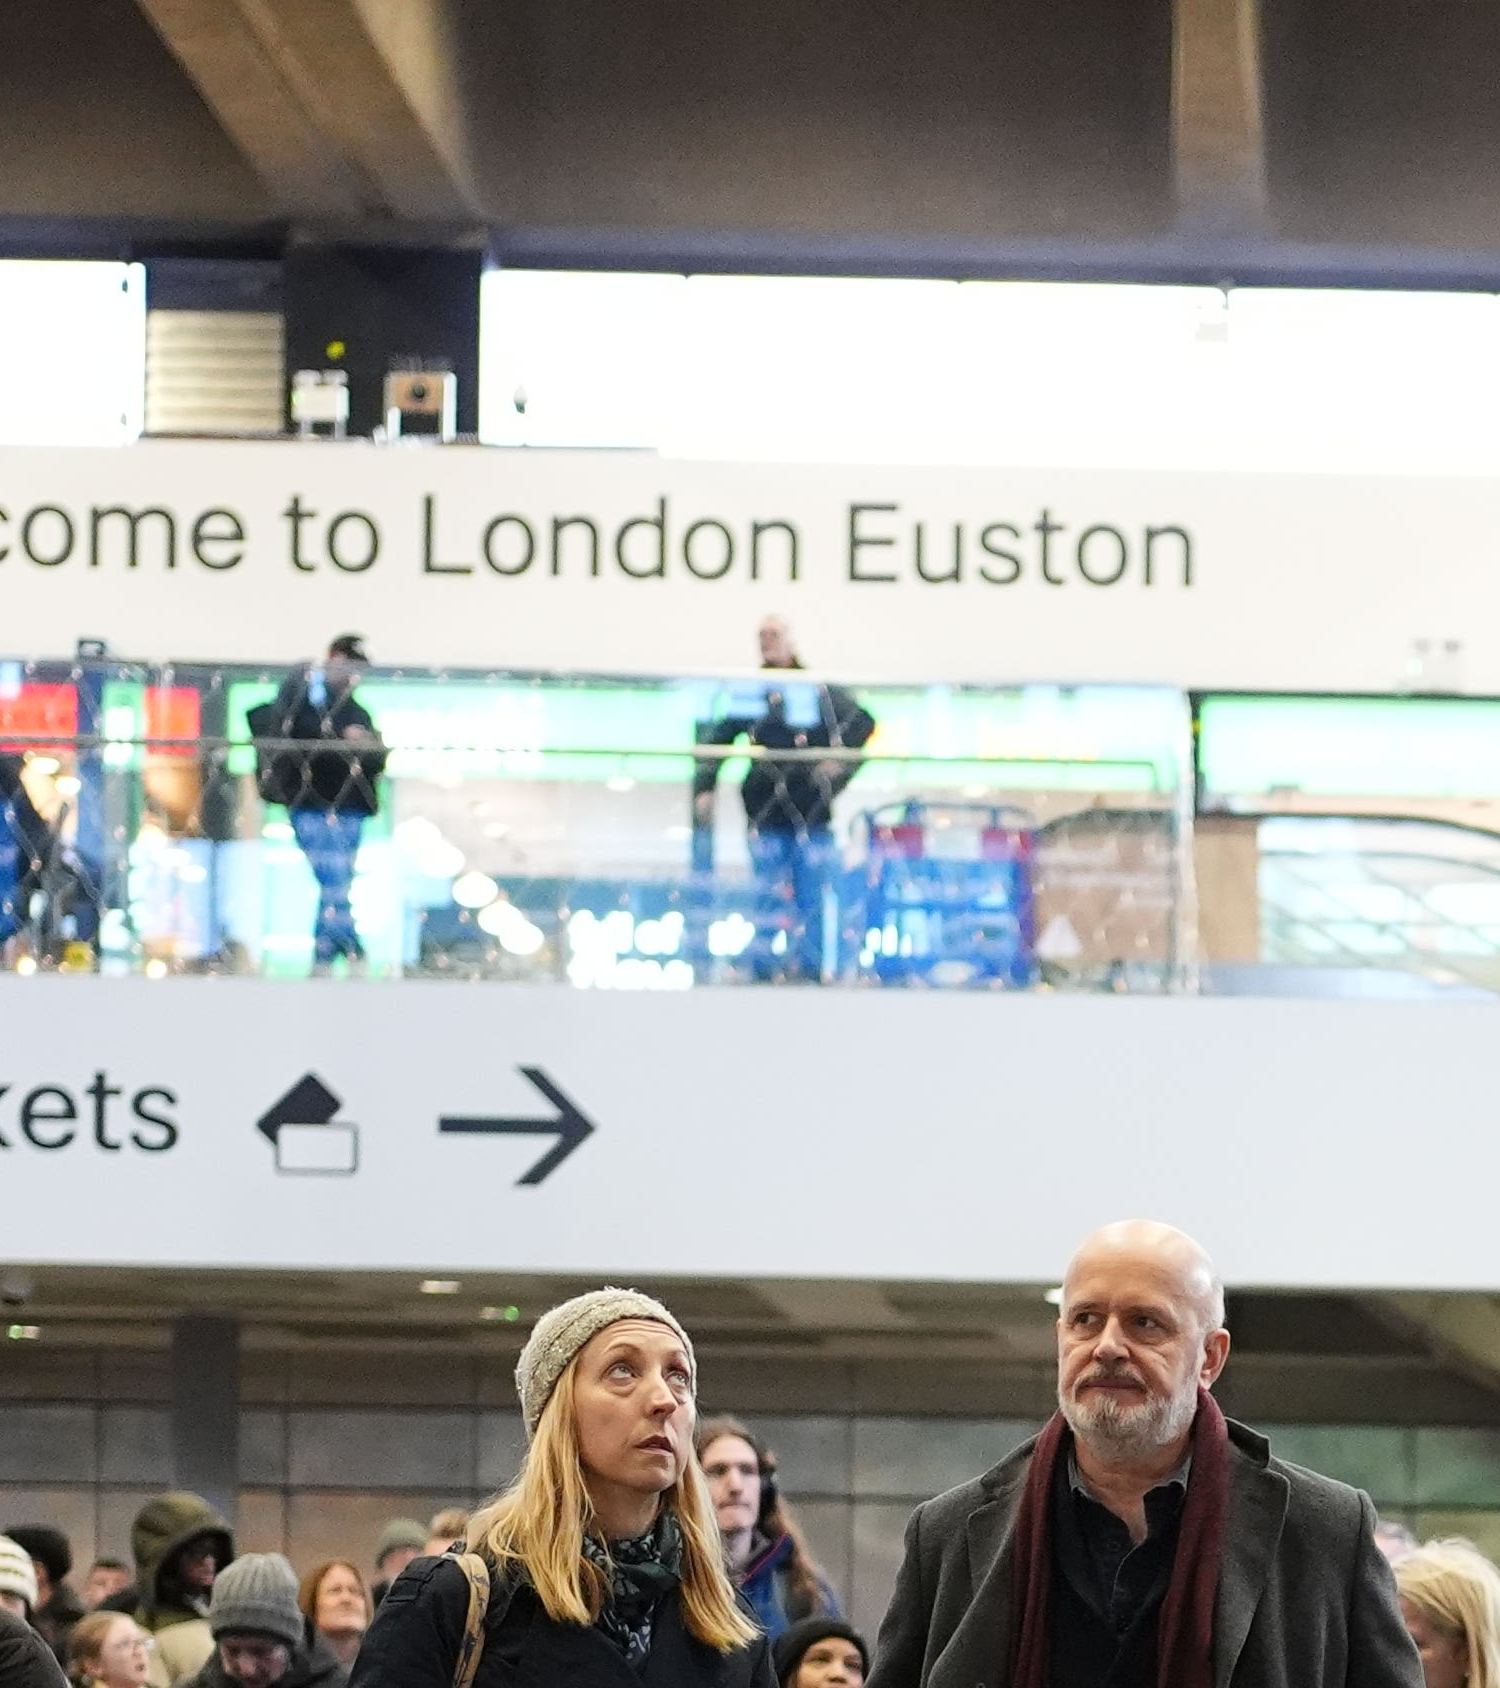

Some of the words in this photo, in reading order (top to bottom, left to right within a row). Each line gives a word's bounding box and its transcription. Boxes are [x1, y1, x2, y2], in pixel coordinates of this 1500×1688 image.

[283, 494, 380, 573] to
[424, 494, 798, 580] London
[849, 504, 1192, 587] Euston
